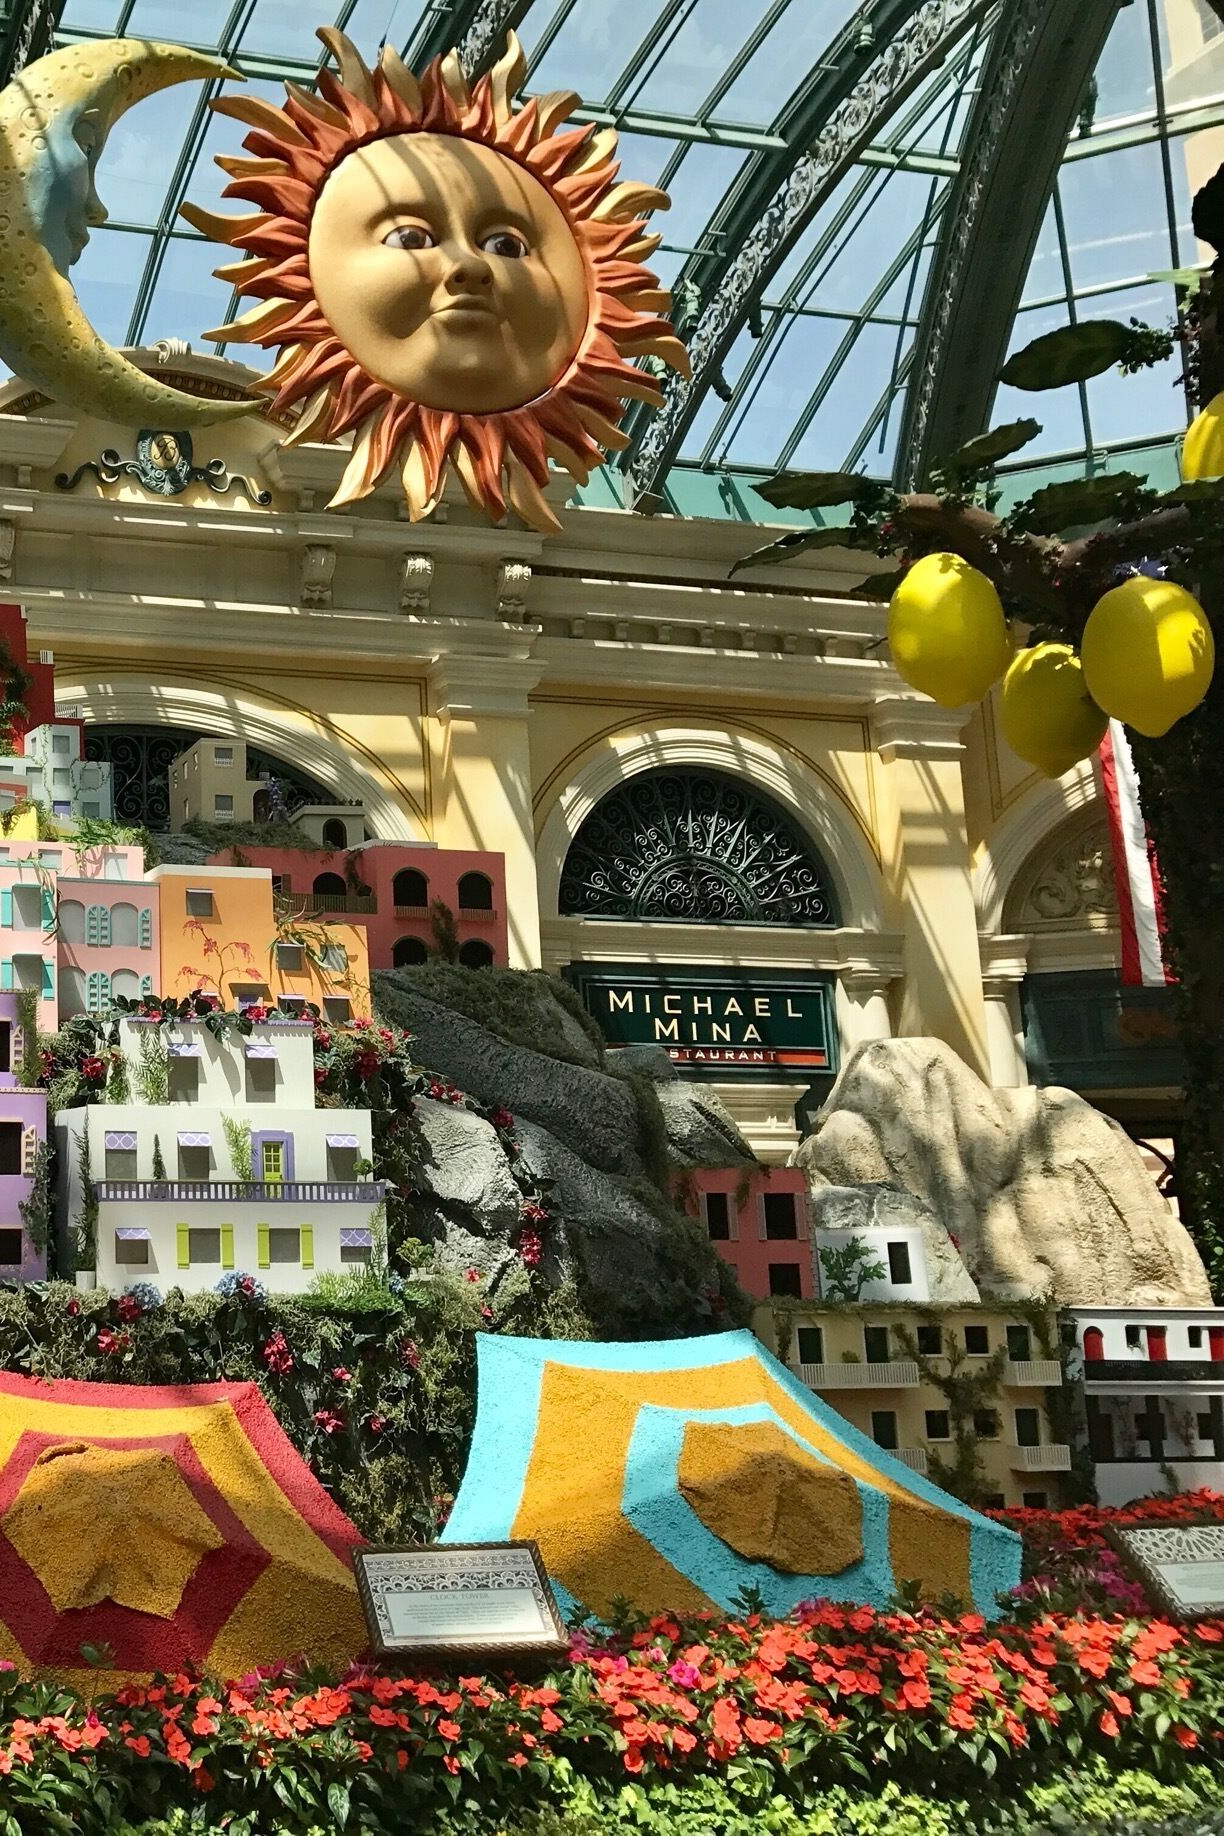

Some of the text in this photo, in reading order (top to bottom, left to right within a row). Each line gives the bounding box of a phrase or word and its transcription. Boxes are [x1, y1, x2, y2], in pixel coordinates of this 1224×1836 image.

[608, 990, 803, 1018] MICHAEL
[654, 1018, 763, 1042] MINA
[668, 1048, 777, 1062] STAURANT
